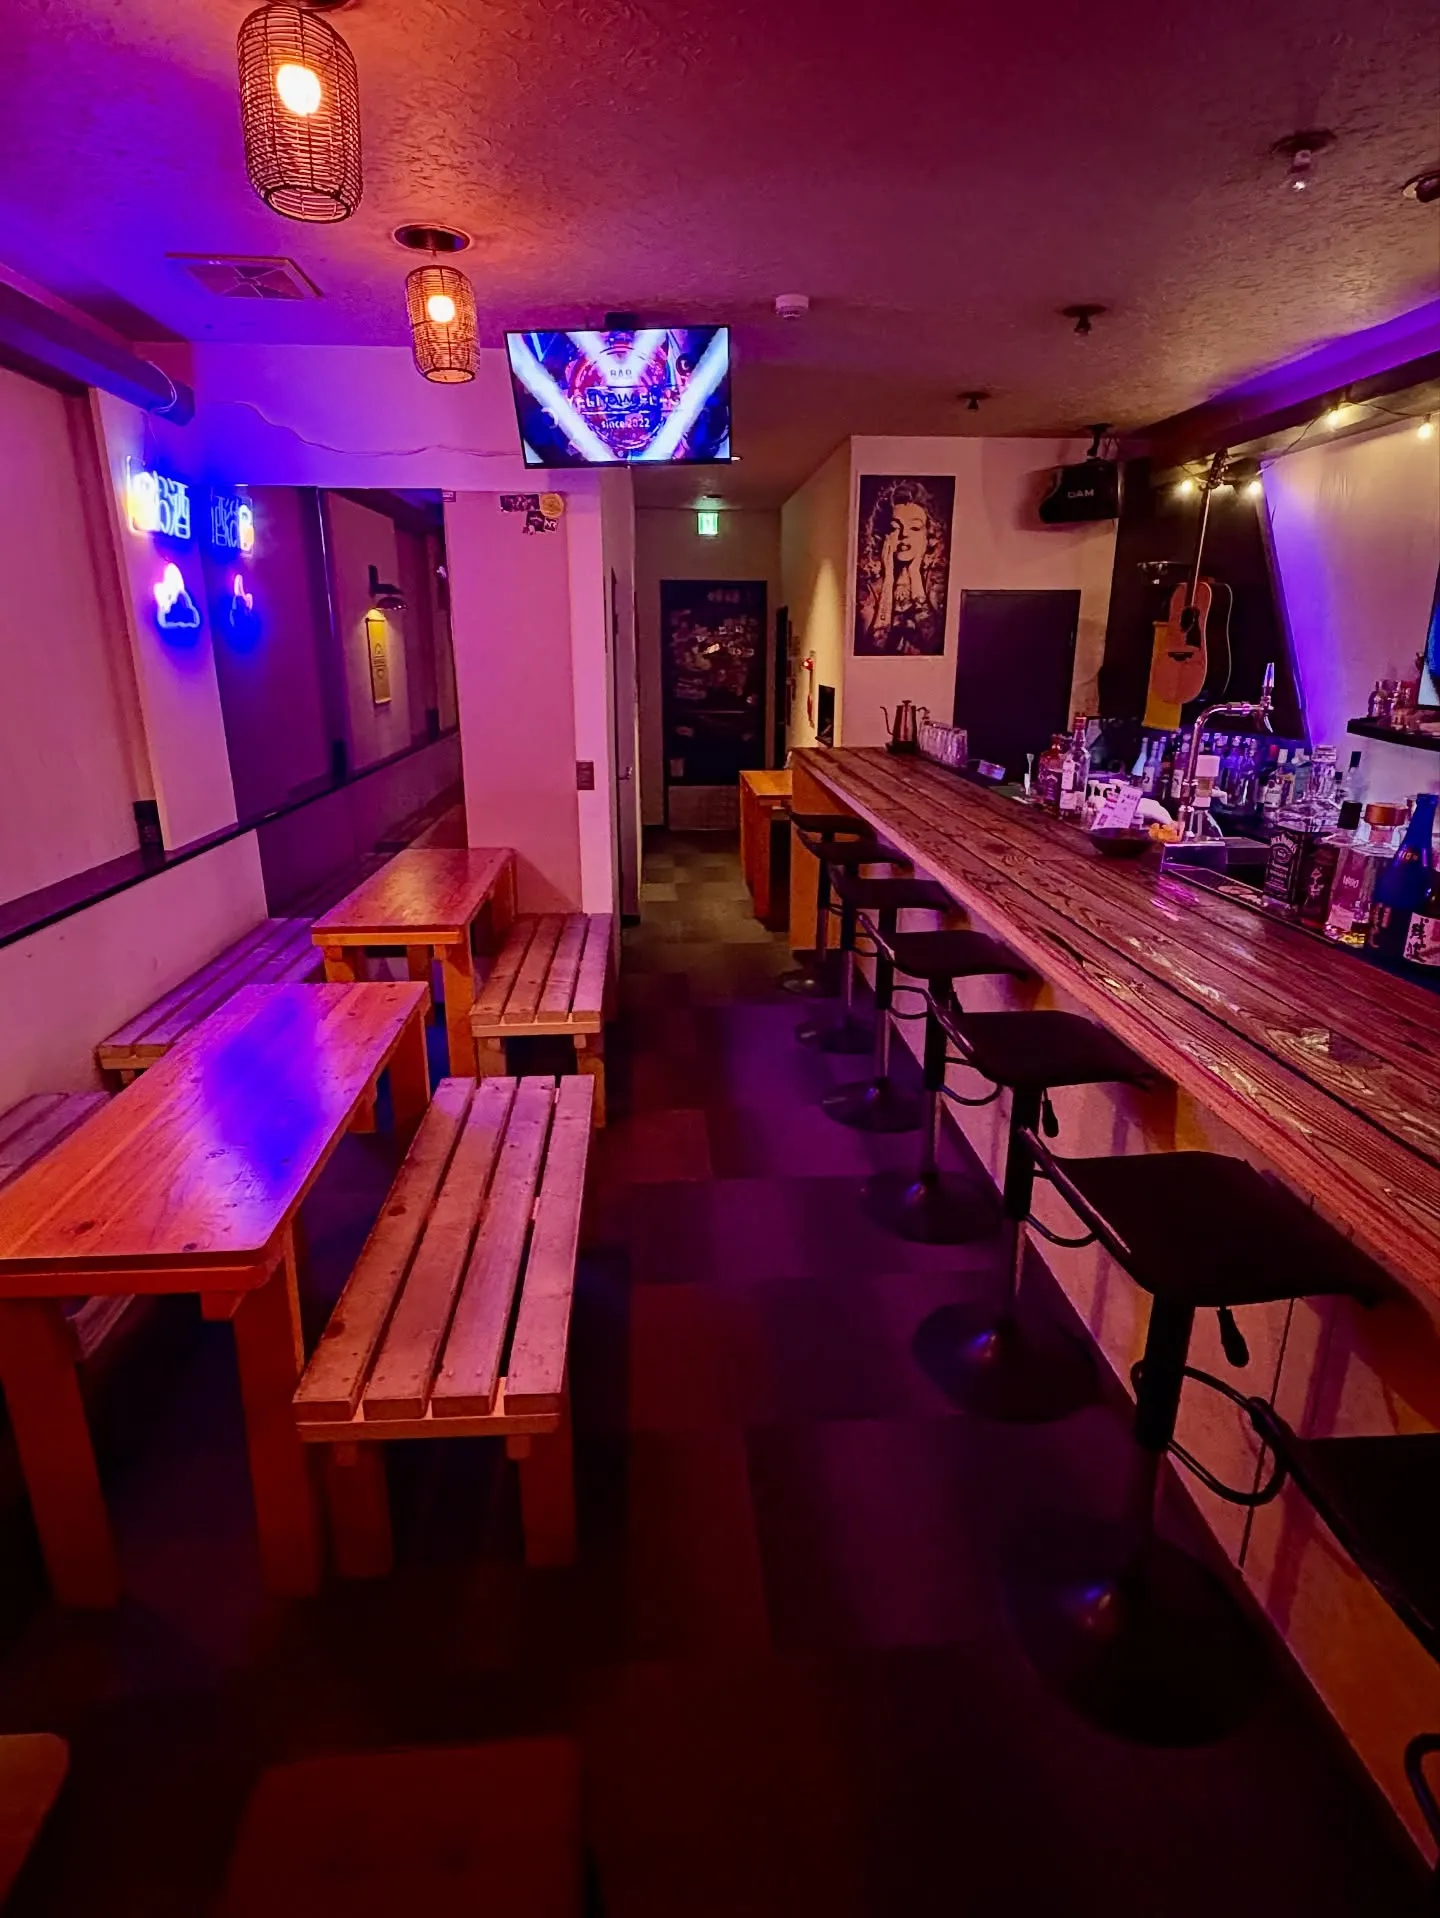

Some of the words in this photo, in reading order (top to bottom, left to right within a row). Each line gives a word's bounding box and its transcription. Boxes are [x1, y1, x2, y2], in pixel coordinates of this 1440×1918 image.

[601, 419, 625, 429] since
[626, 418, 650, 428] 2022
[1067, 488, 1095, 499] DAM
